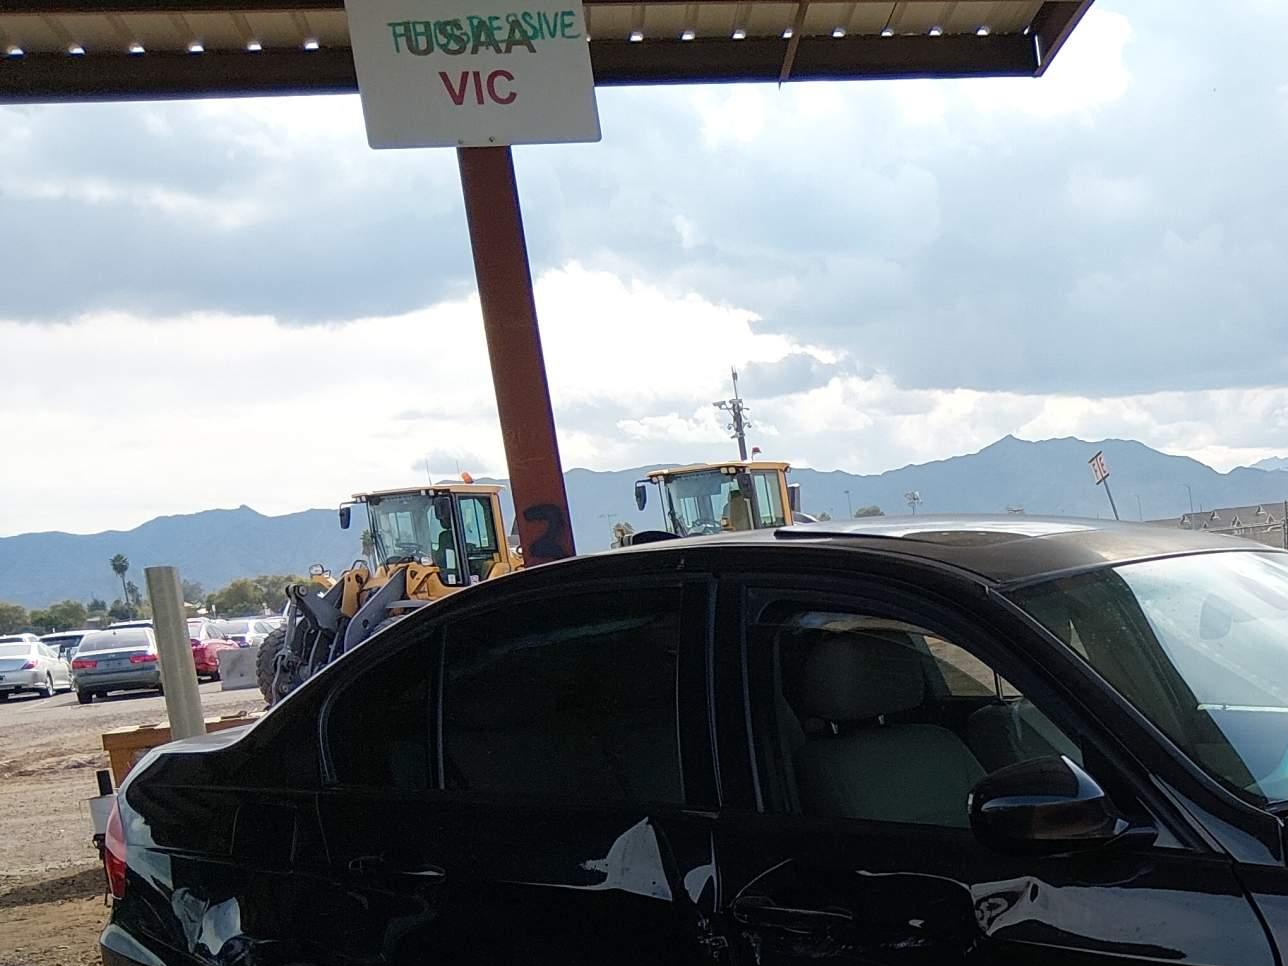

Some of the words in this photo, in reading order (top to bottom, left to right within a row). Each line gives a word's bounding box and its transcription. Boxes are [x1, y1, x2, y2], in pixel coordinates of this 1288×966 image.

[404, 19, 537, 56] USAA
[438, 69, 518, 106] VIC
[523, 503, 564, 560] 2
